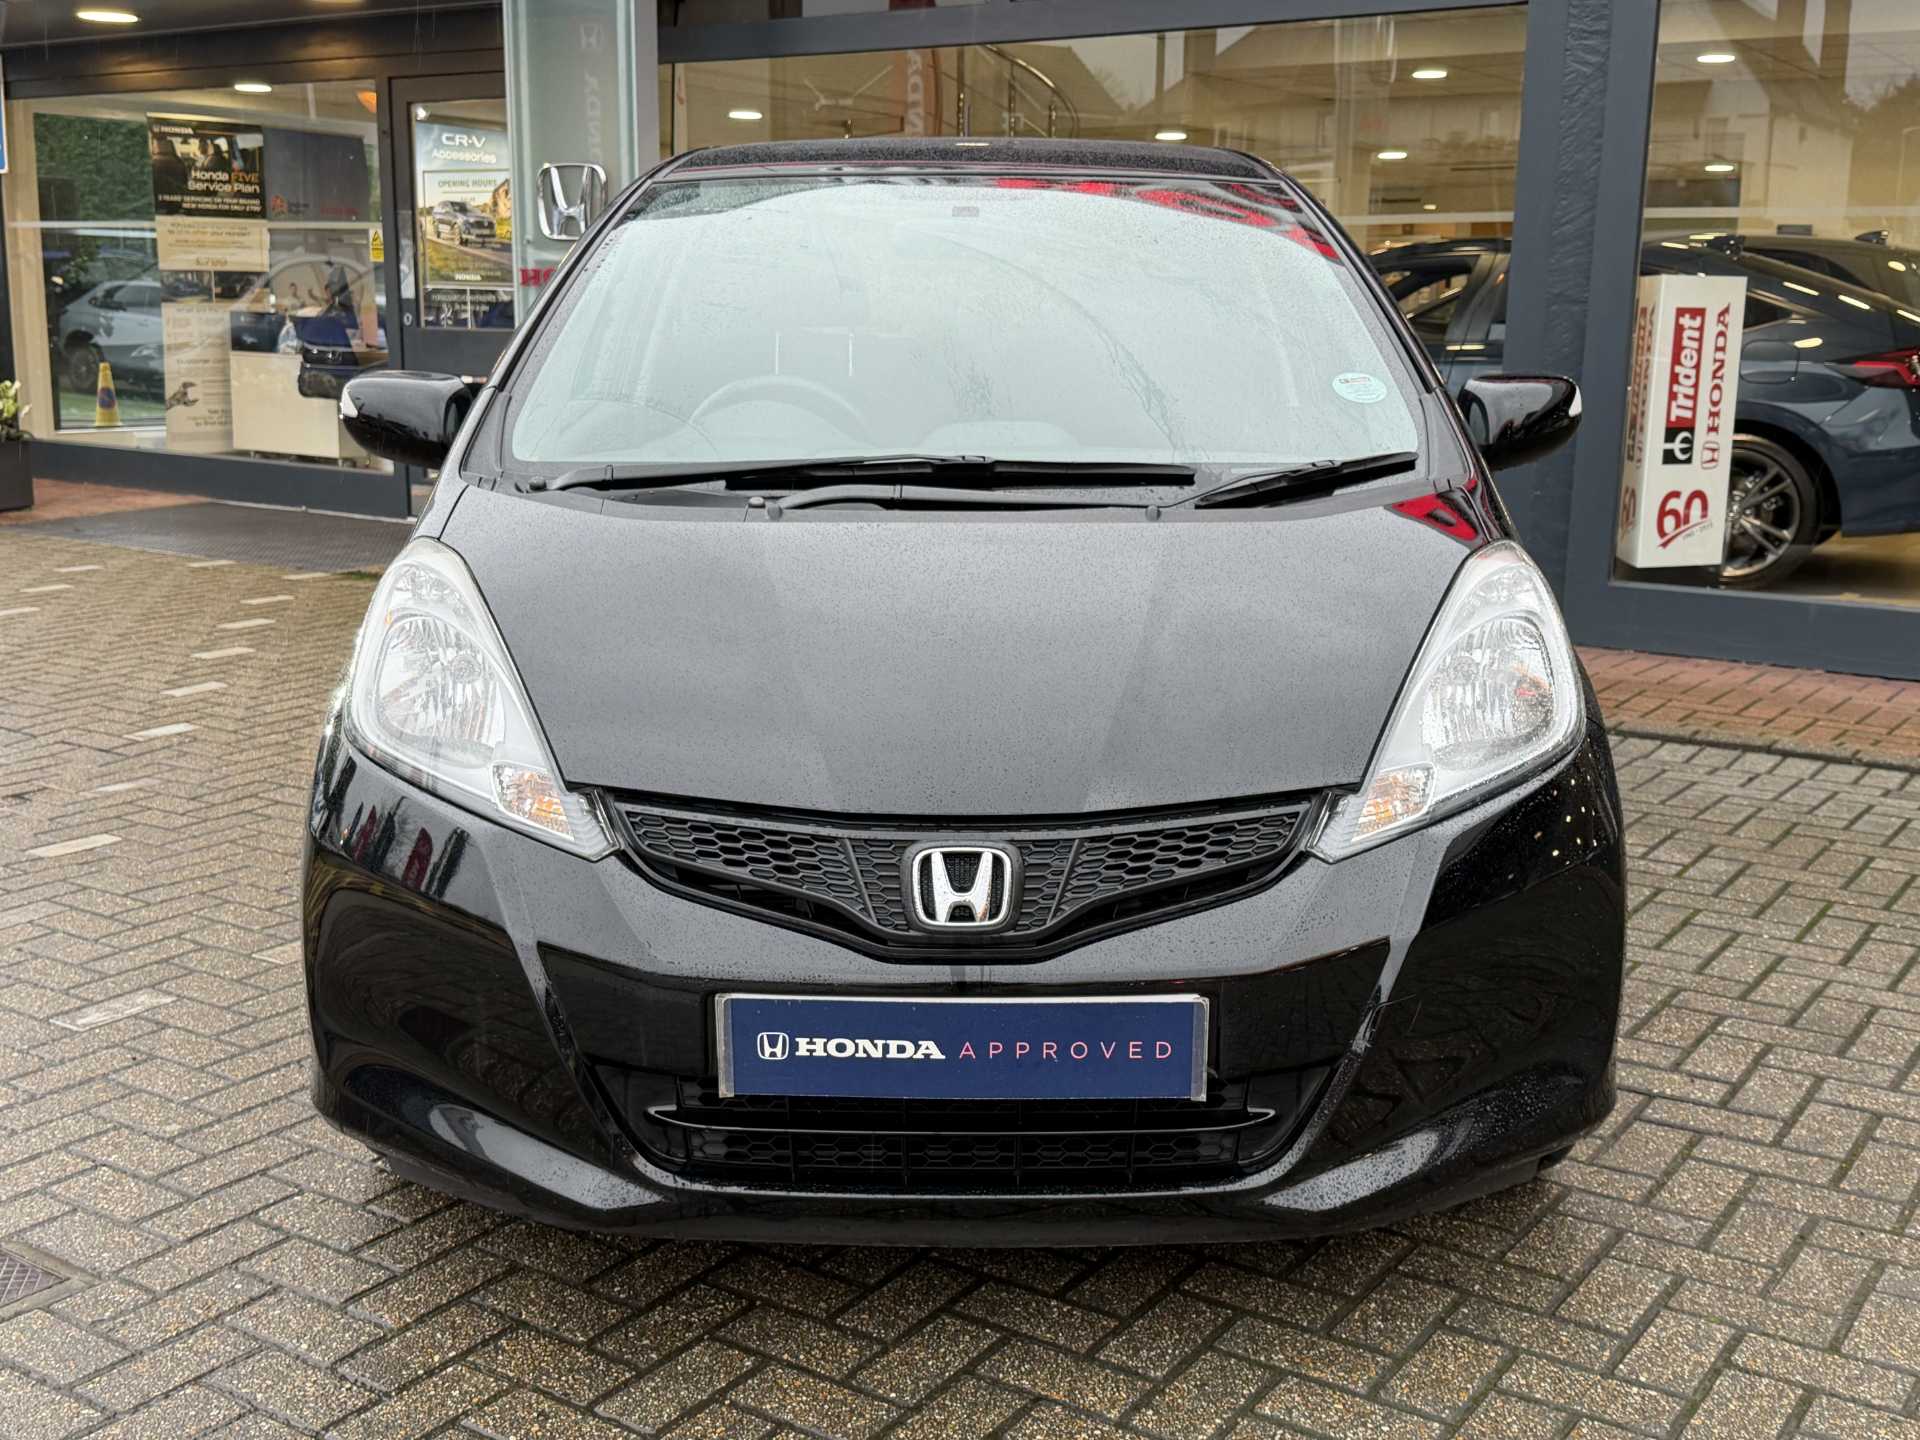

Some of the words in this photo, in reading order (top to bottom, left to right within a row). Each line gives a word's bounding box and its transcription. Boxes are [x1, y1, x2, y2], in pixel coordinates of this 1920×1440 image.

[432, 148, 497, 164] Accessories
[191, 169, 229, 181] Honda
[187, 180, 232, 192] Service
[234, 183, 260, 194] Plan
[1669, 313, 1702, 423] Trident
[1707, 302, 1731, 436] HONDA
[1656, 489, 1709, 540] 60
[795, 1037, 946, 1060] HONDA
[958, 1041, 1173, 1060] APPROVED
